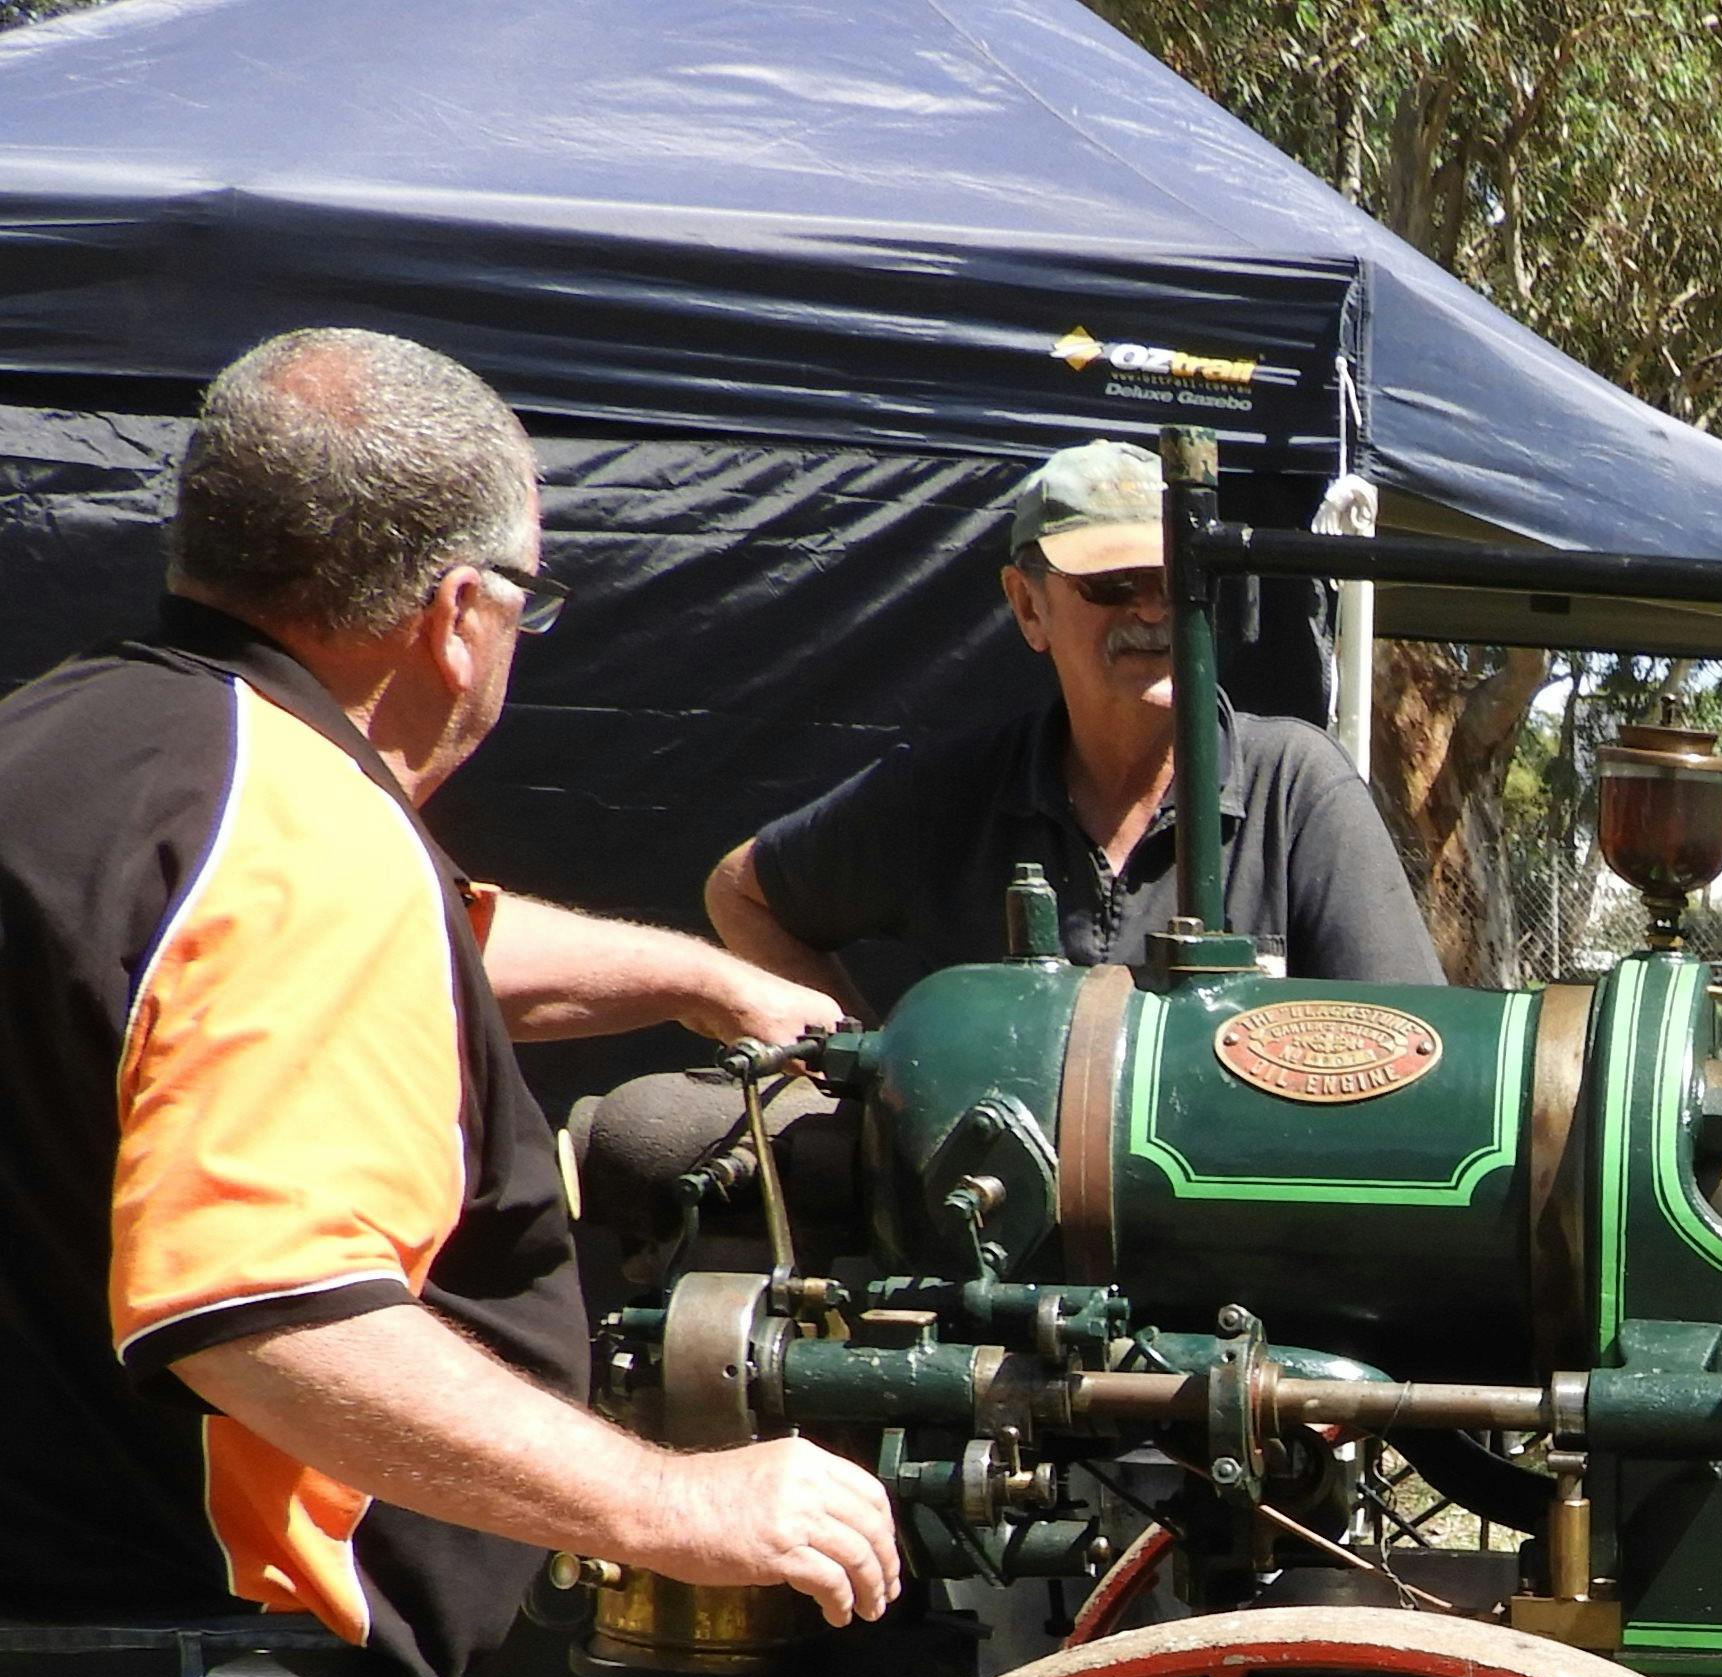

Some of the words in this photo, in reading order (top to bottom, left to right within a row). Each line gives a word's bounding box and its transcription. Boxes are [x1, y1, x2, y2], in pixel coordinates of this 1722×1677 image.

[1105, 382, 1174, 403] Deluxe
[1177, 391, 1253, 411] Gazebo
[1239, 1010, 1279, 1033] THE
[1249, 1059, 1289, 1088] OIL
[1305, 1064, 1401, 1095] ENGINE
